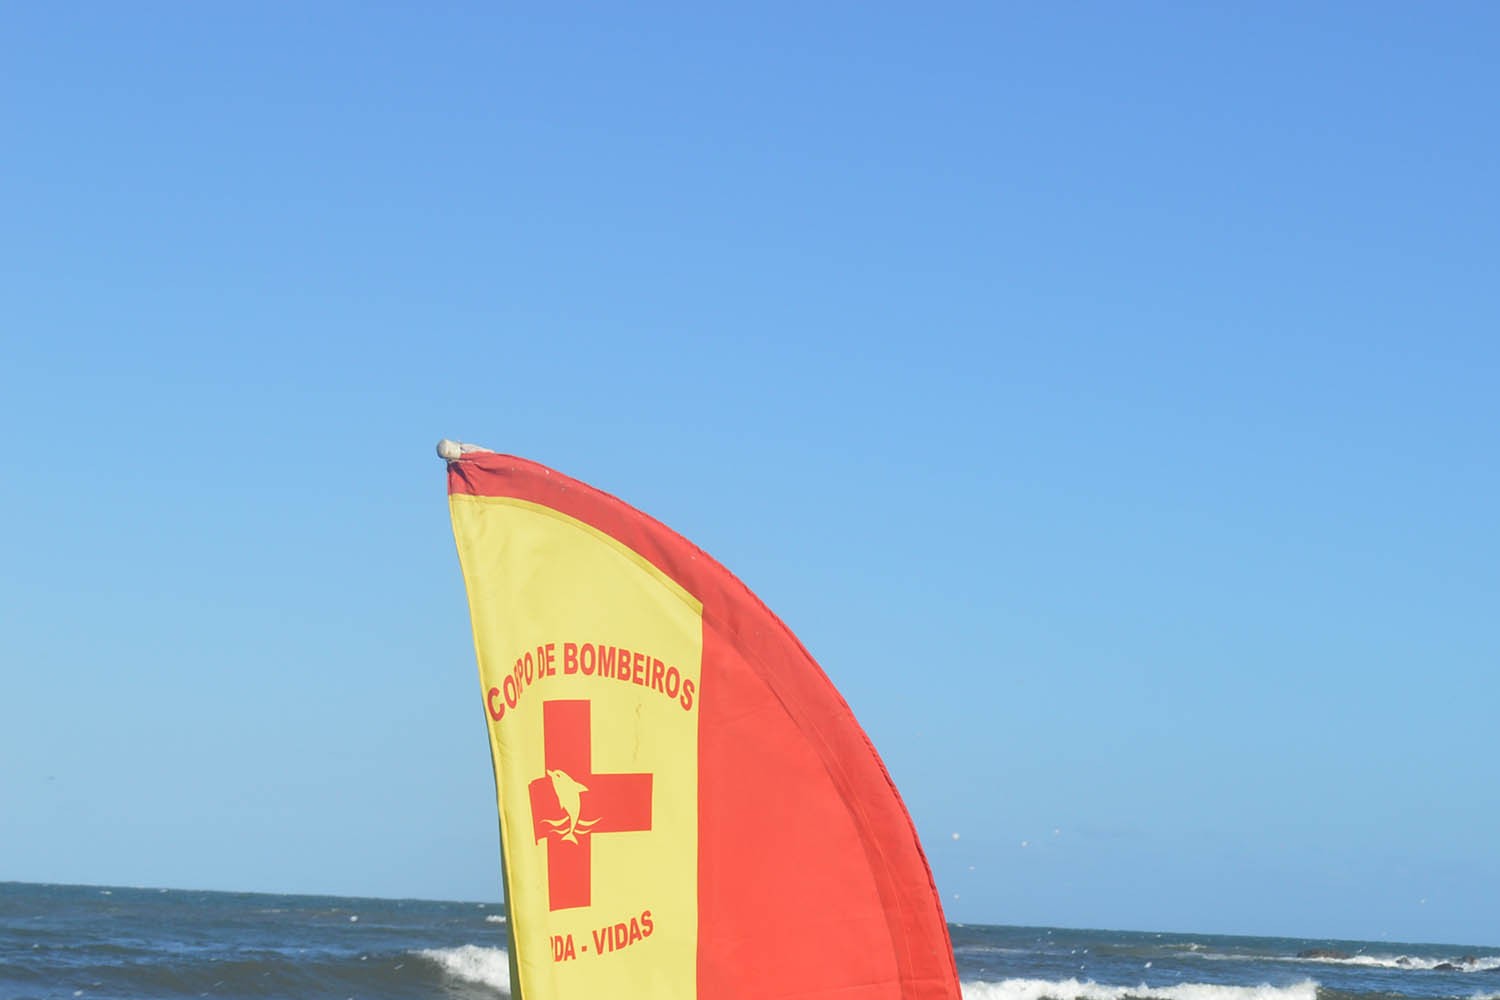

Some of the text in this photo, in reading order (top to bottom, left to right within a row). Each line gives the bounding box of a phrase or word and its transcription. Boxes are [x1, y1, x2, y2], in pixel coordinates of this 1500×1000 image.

[537, 643, 556, 679] DE
[563, 642, 696, 711] BOMBEIROS
[592, 910, 654, 956] VIDAS
